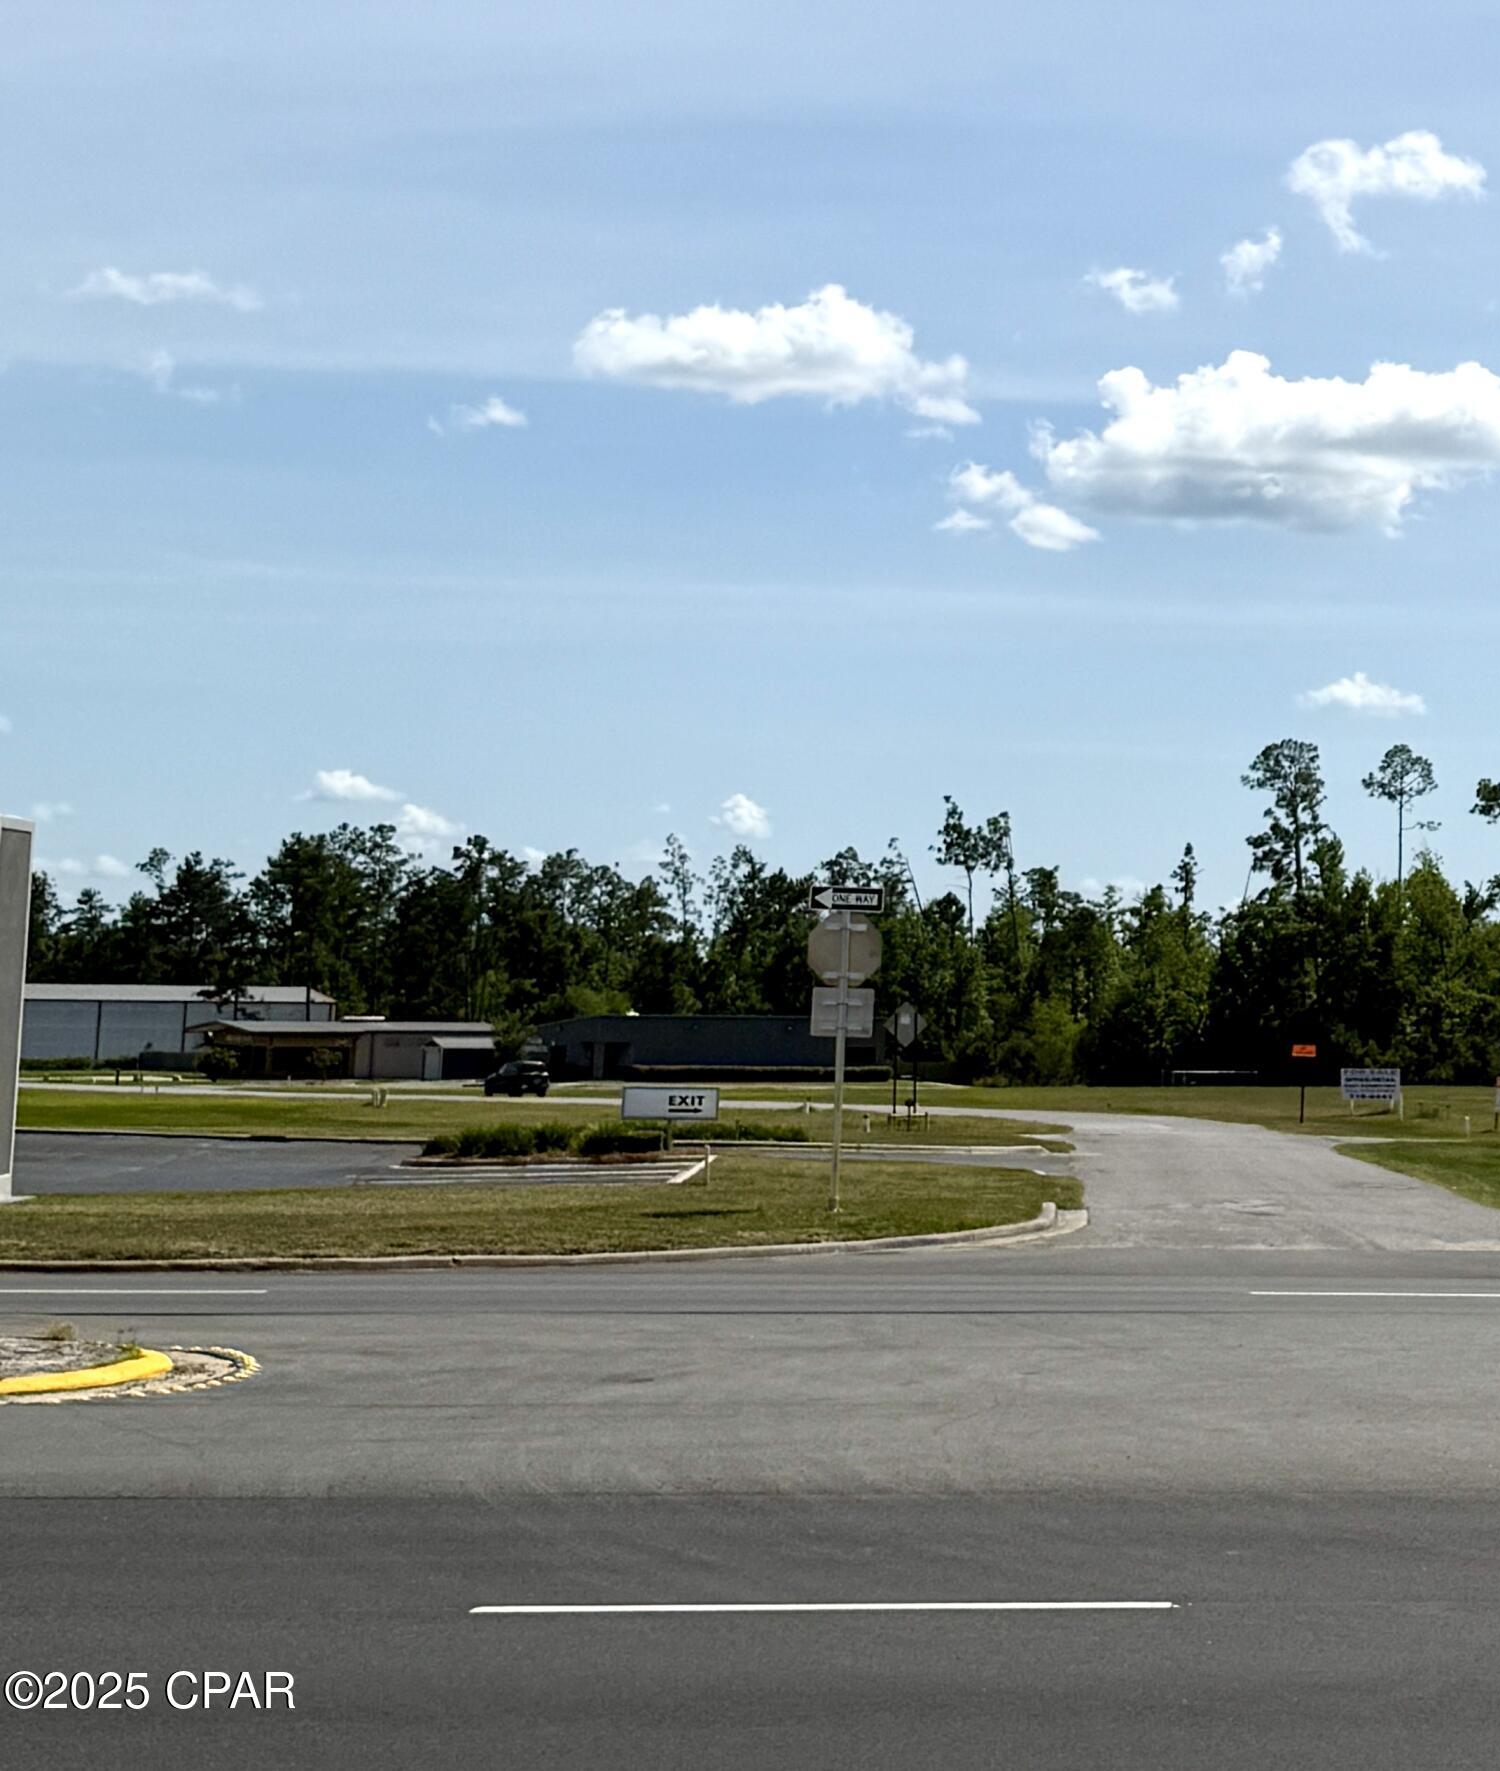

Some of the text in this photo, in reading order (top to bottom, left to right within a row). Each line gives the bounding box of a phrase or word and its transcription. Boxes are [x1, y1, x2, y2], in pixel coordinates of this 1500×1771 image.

[833, 893, 876, 904] ONE WAY
[668, 1095, 705, 1106] EXIT
